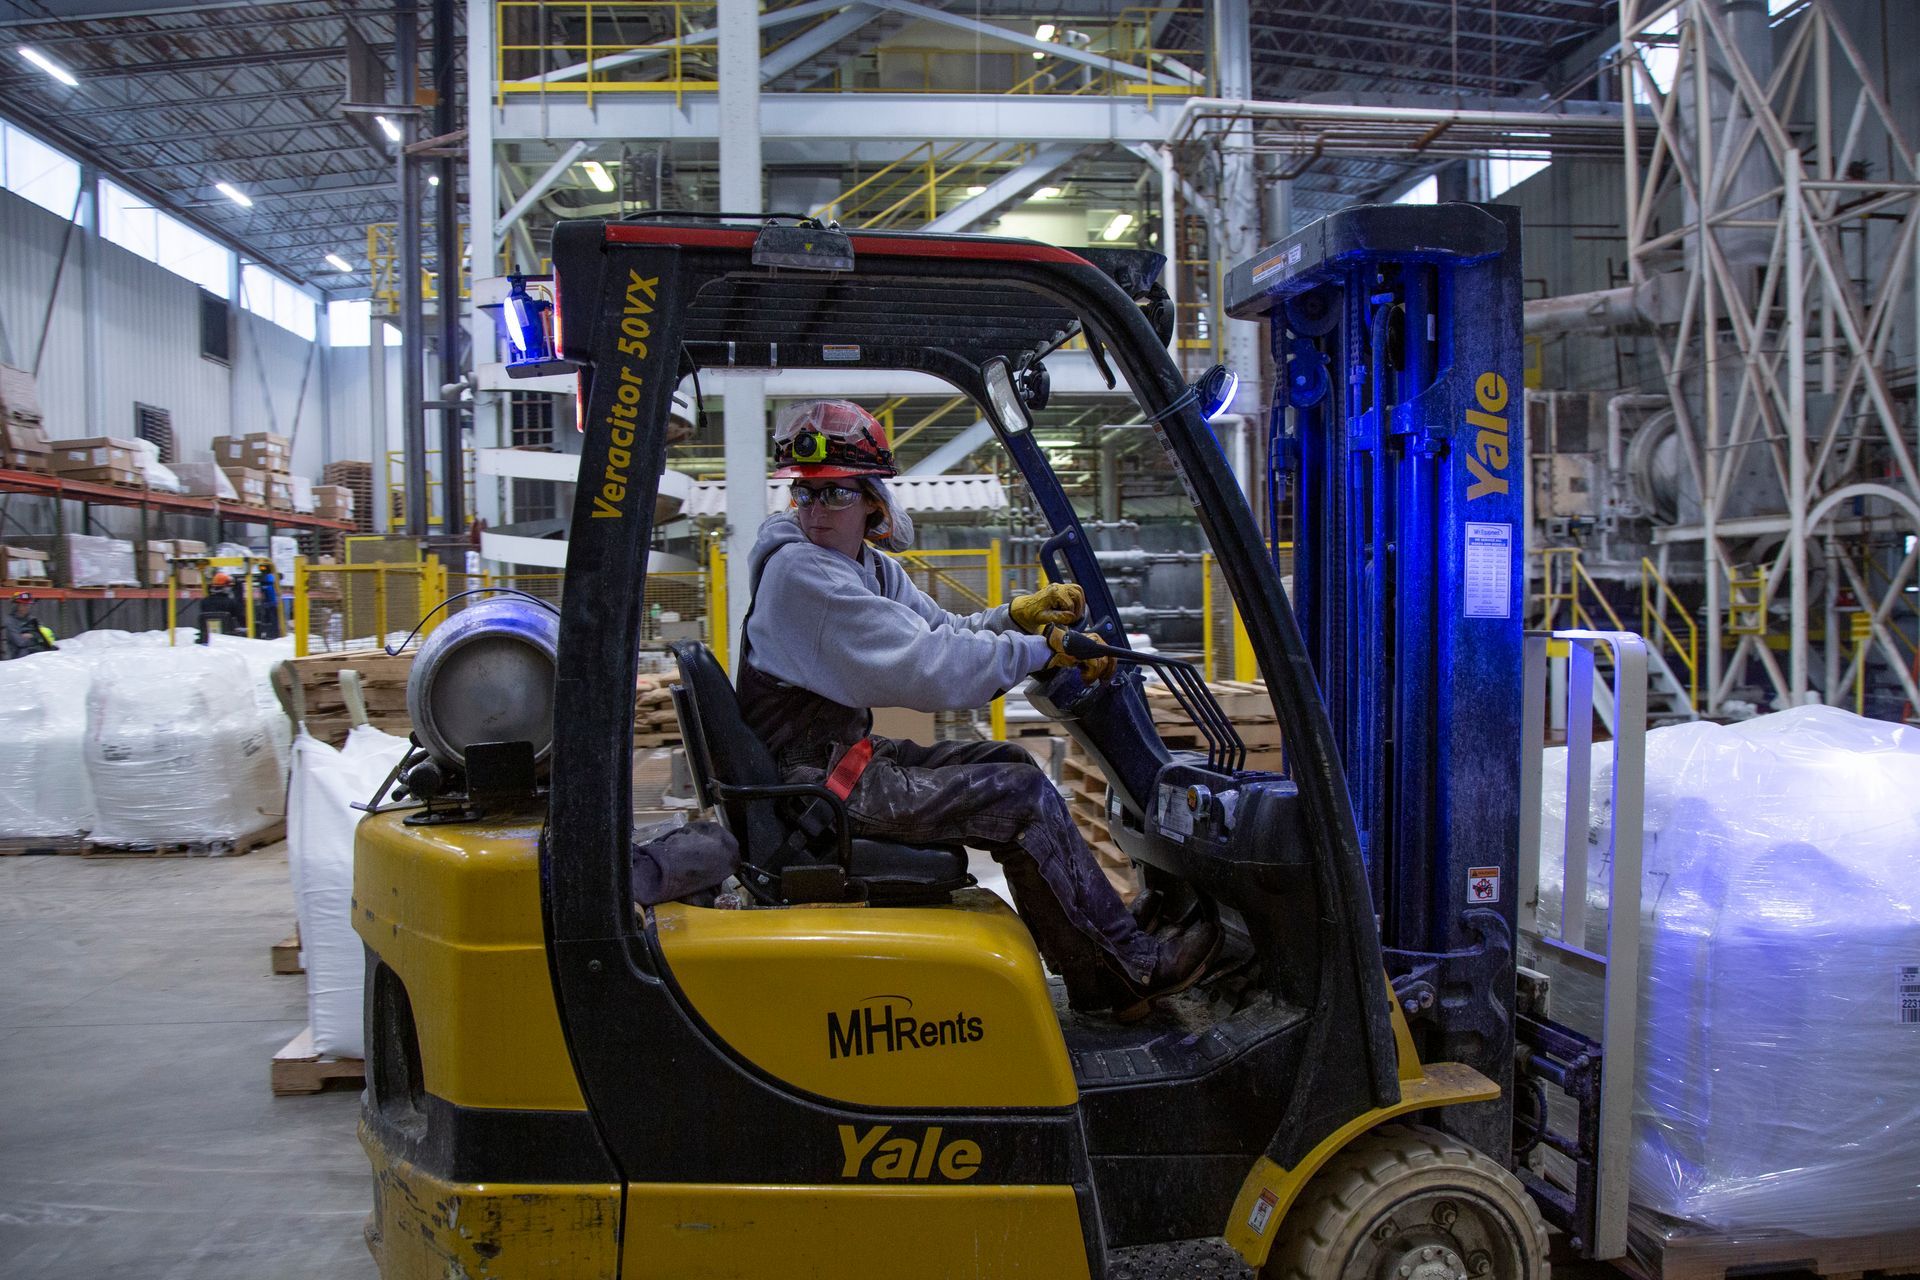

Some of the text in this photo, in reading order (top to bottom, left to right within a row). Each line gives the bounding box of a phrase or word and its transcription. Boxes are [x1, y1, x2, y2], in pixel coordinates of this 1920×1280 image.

[591, 268, 659, 518] Veracitor 50VX
[1465, 371, 1508, 501] Yale
[838, 1124, 982, 1180] Yale
